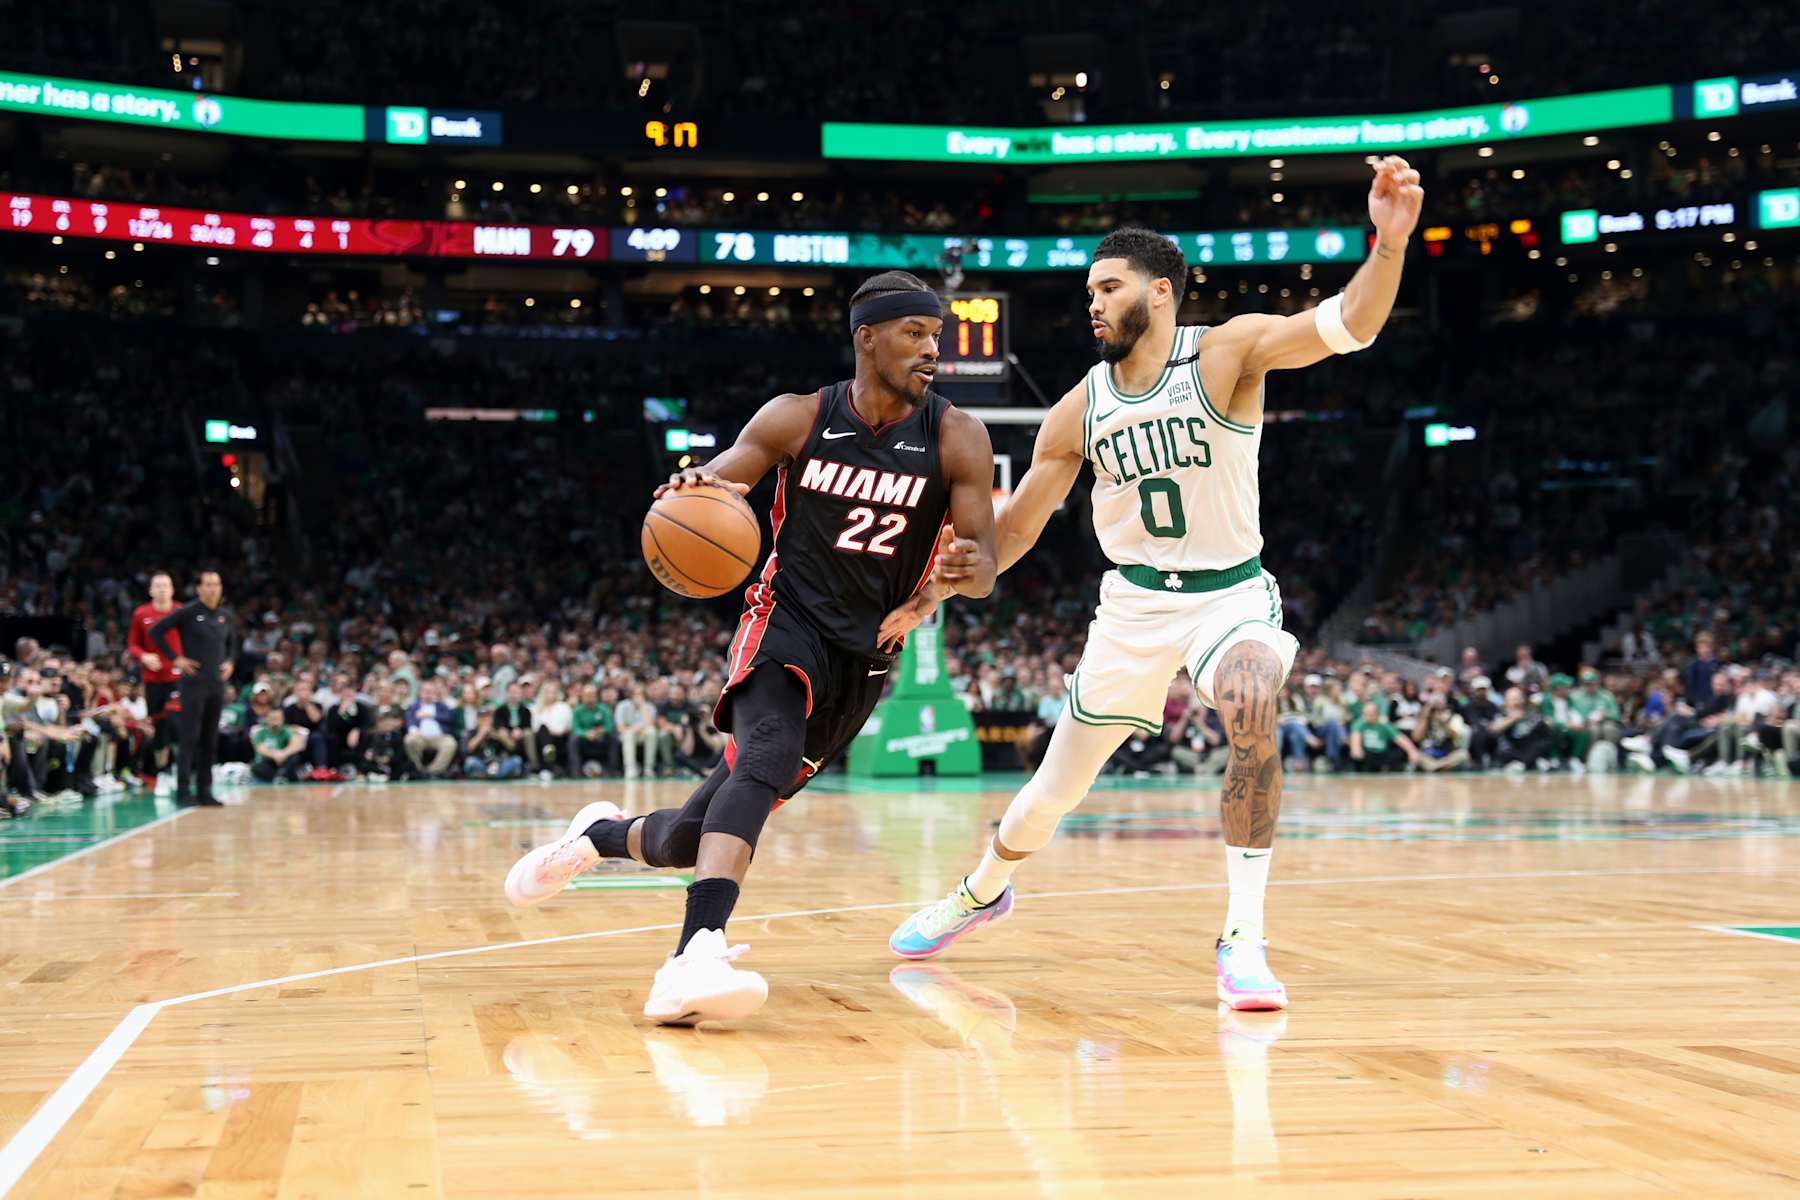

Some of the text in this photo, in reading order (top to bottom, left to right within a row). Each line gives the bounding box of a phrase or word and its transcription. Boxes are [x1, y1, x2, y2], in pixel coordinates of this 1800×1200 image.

[43, 82, 90, 110] has
[91, 93, 110, 112] a
[112, 94, 181, 122] story.
[1698, 79, 1797, 111] TD Bank
[389, 112, 482, 137] TD Bank
[947, 132, 1011, 159] Every
[1052, 132, 1095, 154] has
[1096, 135, 1113, 153] a
[1114, 132, 1178, 154] story.
[1186, 127, 1251, 151] Every
[1252, 126, 1360, 147] customer
[1361, 120, 1404, 143] has
[1405, 122, 1423, 141] a
[1425, 117, 1490, 138] story.
[1763, 193, 1797, 222] TD
[473, 226, 530, 255] MIAMI
[552, 228, 595, 257] 79
[715, 232, 755, 261] 78
[773, 234, 849, 263] BOSTON
[958, 323, 994, 356] 11
[1167, 381, 1191, 398] VISTA
[1169, 392, 1193, 406] PRINT
[1094, 416, 1212, 486] CELTICS
[799, 458, 928, 508] MIAMI
[1138, 477, 1187, 539] 0
[834, 505, 908, 556] 22
